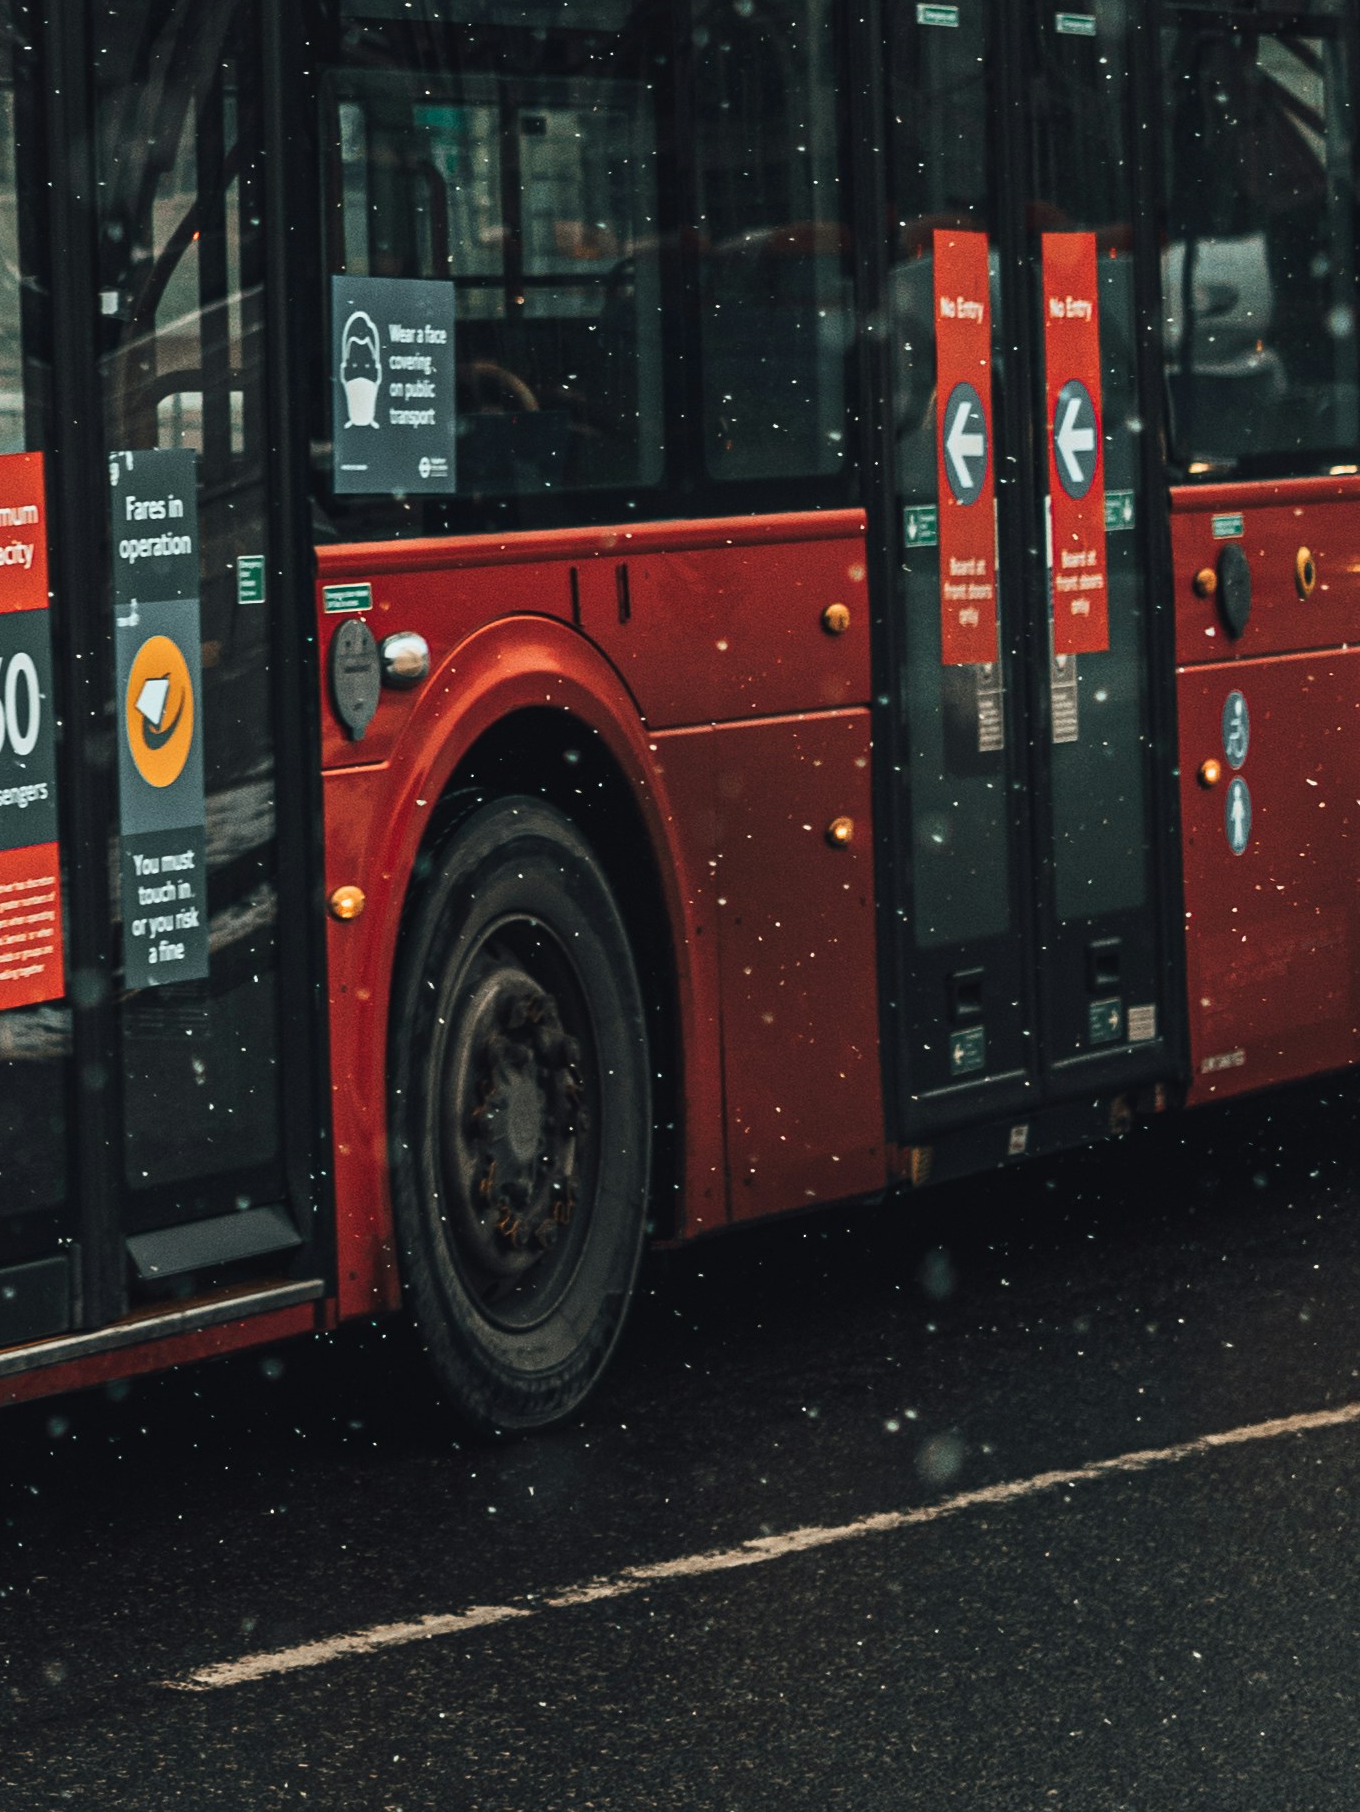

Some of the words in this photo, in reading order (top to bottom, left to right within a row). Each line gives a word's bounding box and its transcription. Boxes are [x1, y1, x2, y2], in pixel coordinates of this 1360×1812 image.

[939, 296, 956, 319] No
[957, 296, 984, 324] Entry
[1049, 297, 1065, 319] No
[1066, 295, 1093, 323] Entry
[388, 324, 416, 343] Wear
[416, 329, 424, 344] a
[424, 324, 448, 344] face
[388, 352, 432, 375] covering
[389, 382, 404, 397] on
[404, 379, 436, 401] public
[389, 408, 436, 429] transport
[125, 495, 166, 521] Fares
[168, 494, 184, 518] in
[119, 531, 192, 564] operation
[132, 854, 160, 876] You
[161, 849, 195, 873] must
[138, 880, 177, 906] touch
[132, 918, 148, 937] or
[149, 915, 174, 940] you
[175, 906, 200, 930] risk
[148, 947, 158, 964] a
[159, 939, 185, 962] fine
